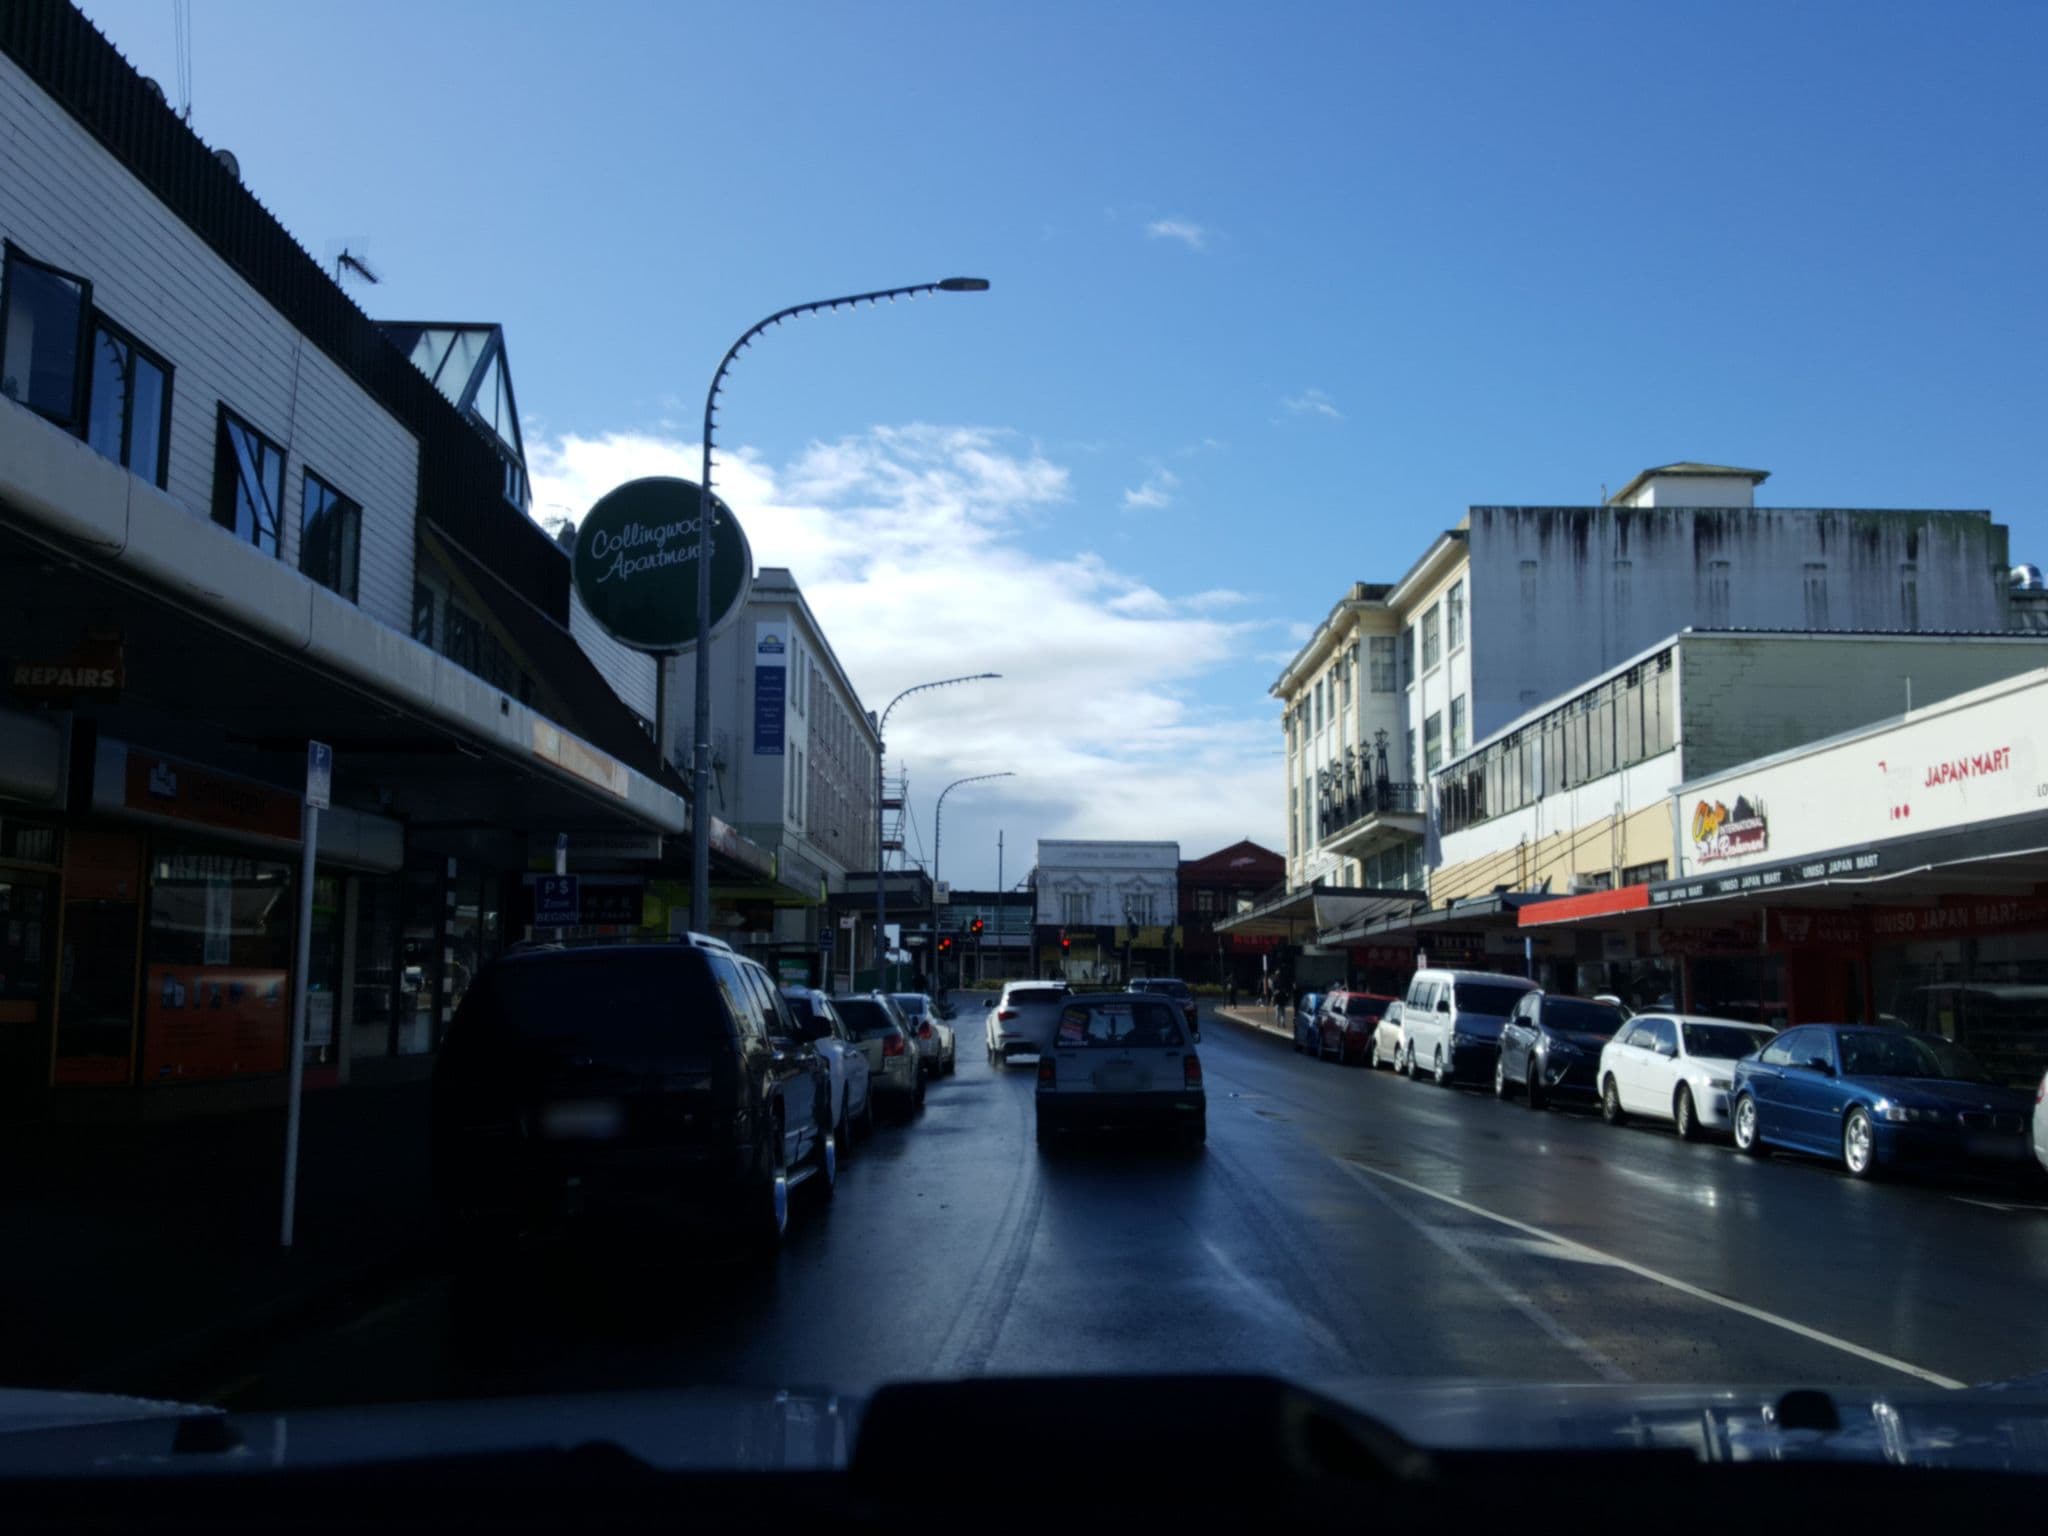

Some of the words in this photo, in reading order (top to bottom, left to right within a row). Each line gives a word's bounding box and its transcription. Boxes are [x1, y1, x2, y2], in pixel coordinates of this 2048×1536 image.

[596, 540, 715, 583] Apartmens
[14, 667, 115, 689] REPAIRS
[1925, 757, 1969, 788] JAPAN
[1972, 747, 2011, 777] MART
[1801, 864, 1825, 879] UNISO
[1829, 860, 1853, 874] JAPAN
[1856, 854, 1879, 869] MART
[544, 880, 555, 894] P
[1741, 875, 1762, 889] JAPAN
[1763, 872, 1782, 886] MART
[1873, 911, 1915, 934] UNISO
[1921, 908, 1969, 931] JAPAN
[1975, 903, 2019, 927] MART
